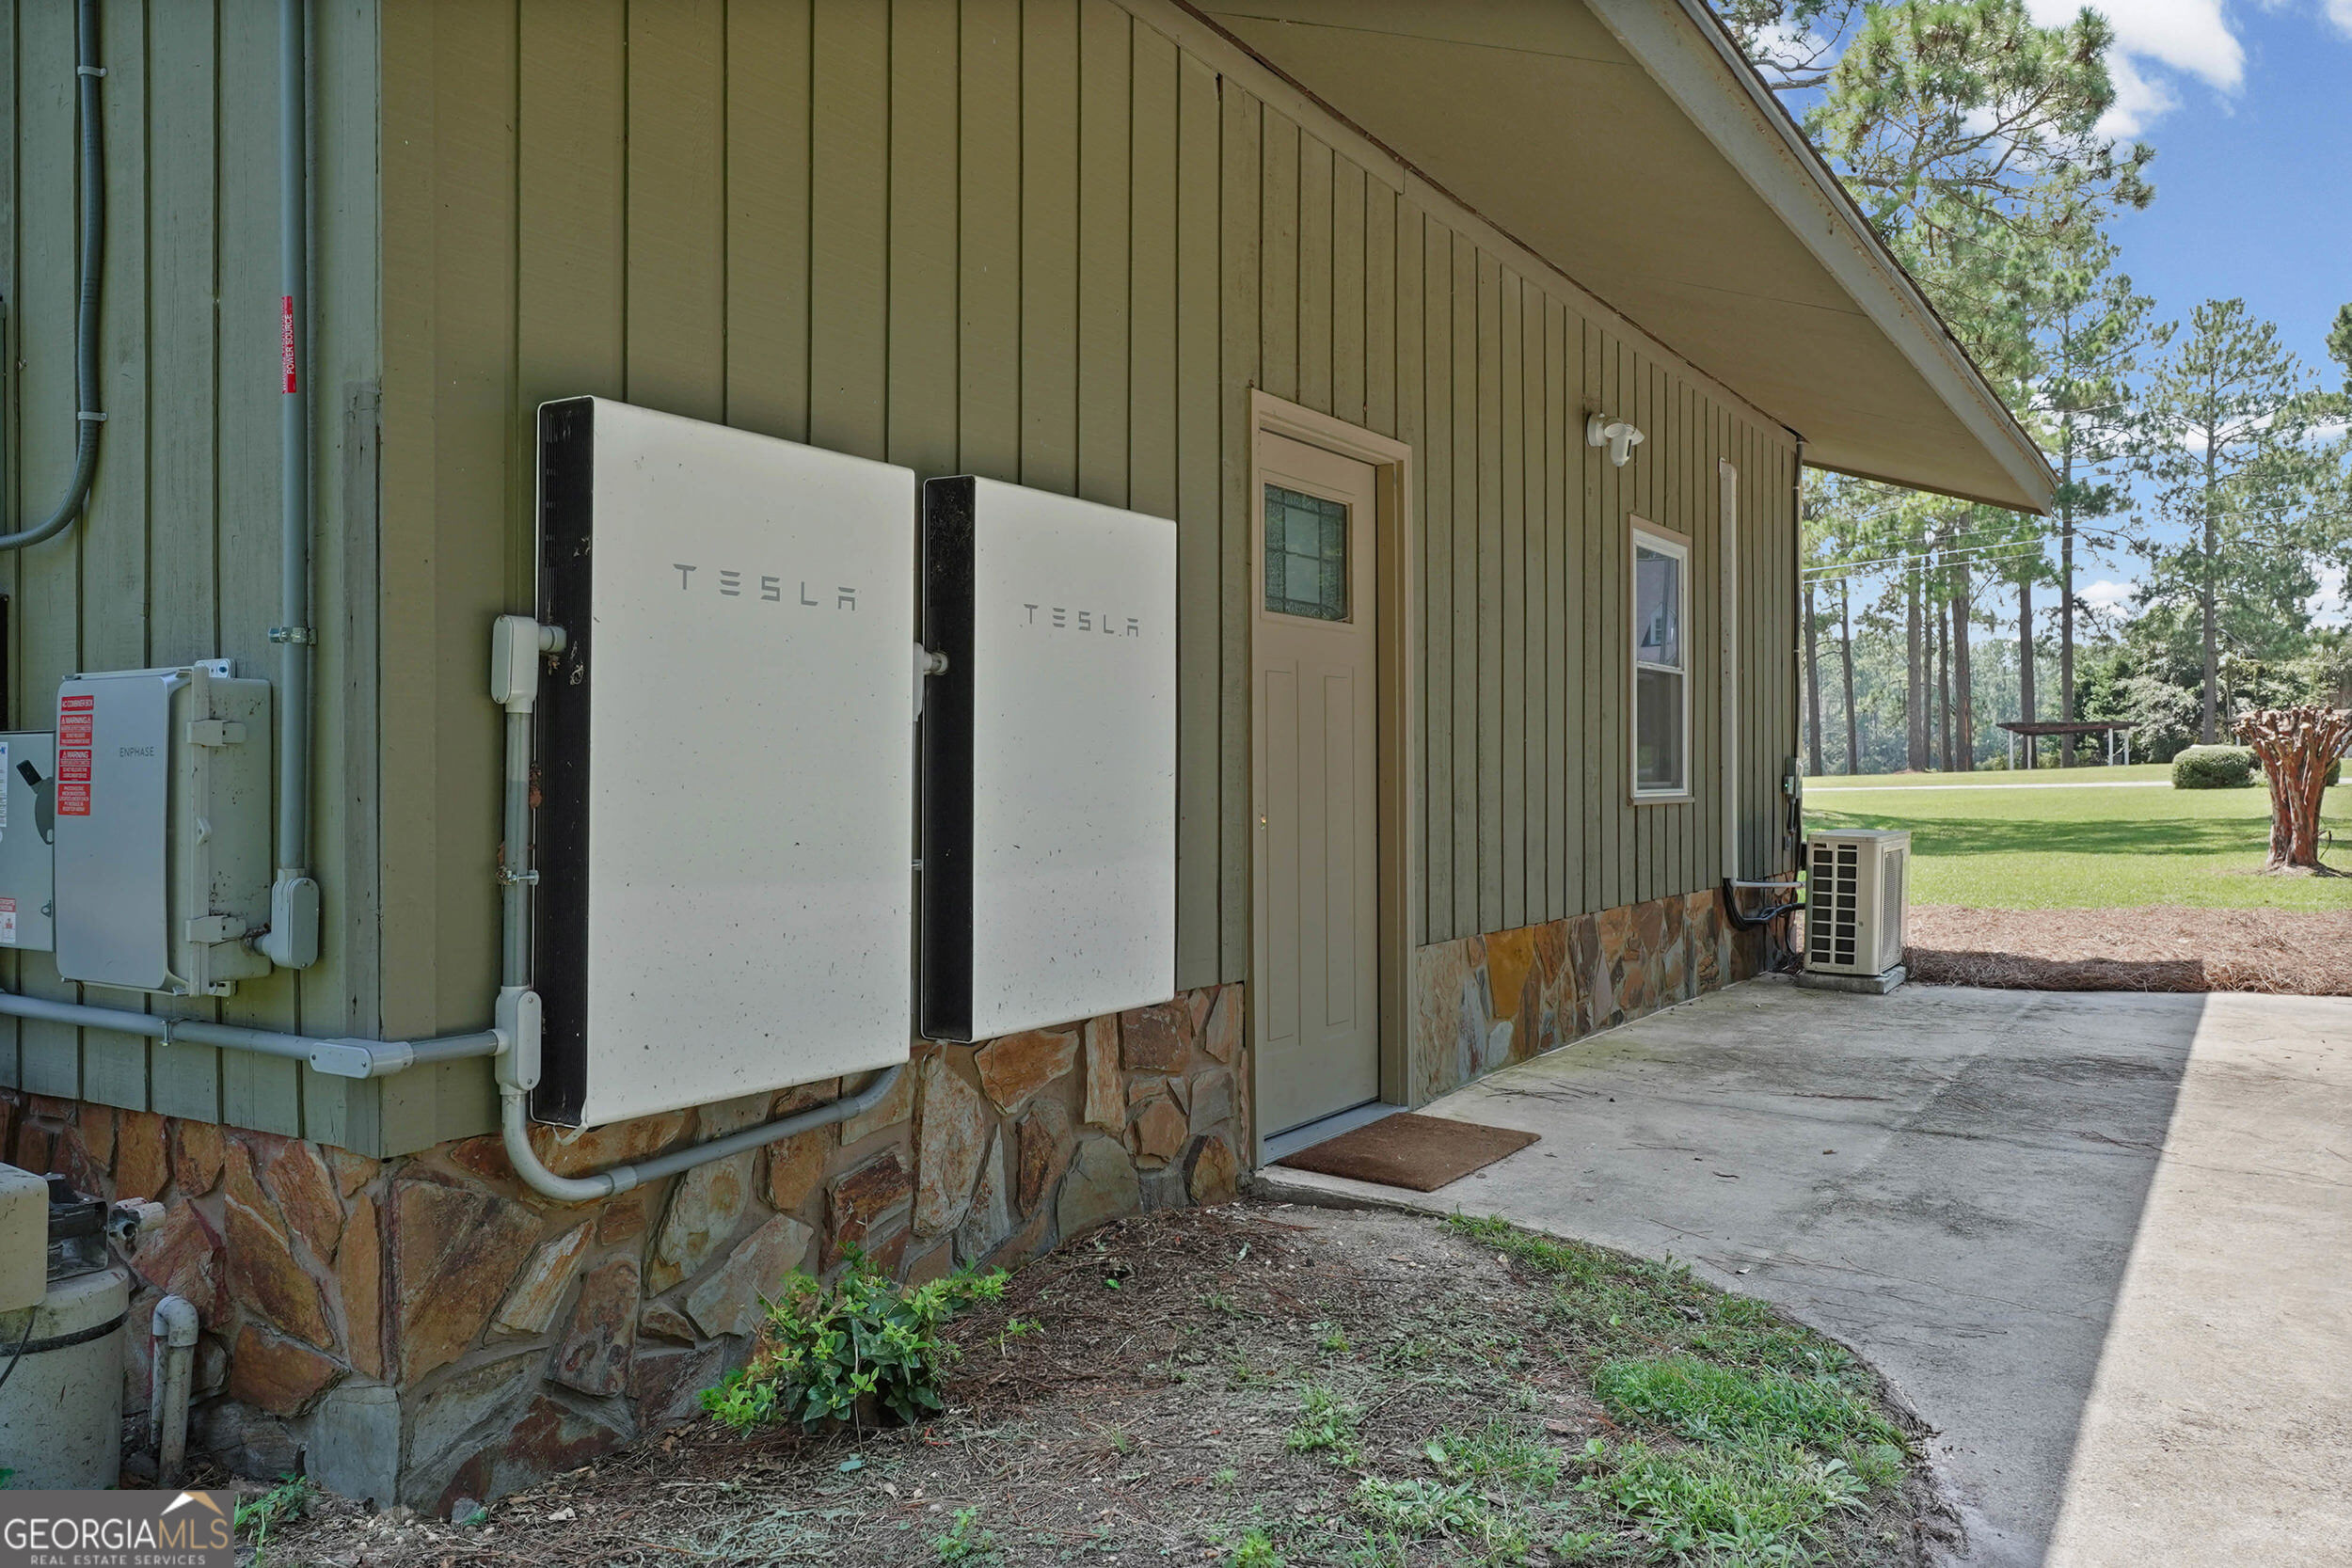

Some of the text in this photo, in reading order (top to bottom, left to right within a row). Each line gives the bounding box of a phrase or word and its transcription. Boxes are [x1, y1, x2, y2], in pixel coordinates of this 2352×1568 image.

[284, 313, 294, 375] POWER SOURCE
[673, 563, 856, 611] TESLA
[1023, 603, 1139, 638] TESLA
[66, 716, 87, 724] WARNING
[67, 751, 88, 759] WARNING
[119, 746, 155, 758] ENPHASE
